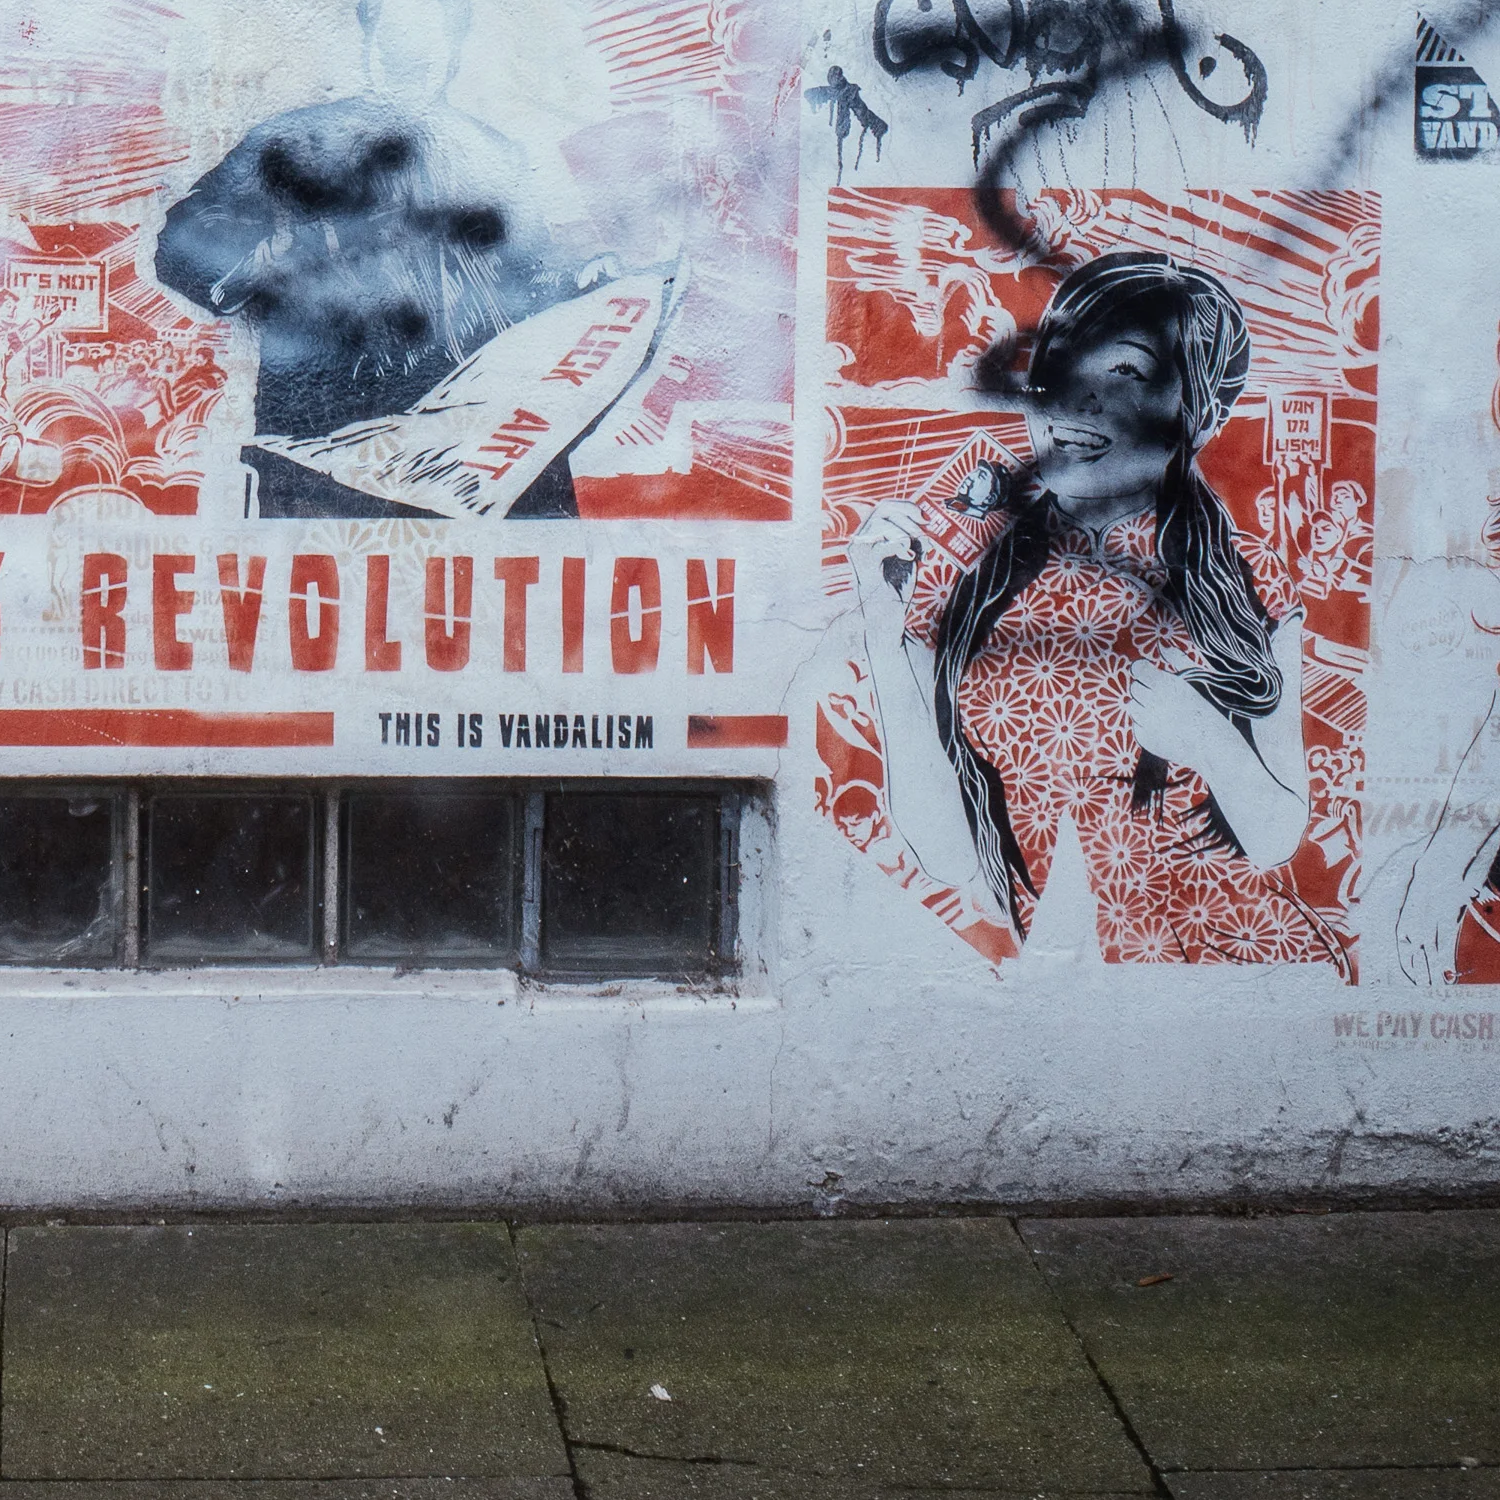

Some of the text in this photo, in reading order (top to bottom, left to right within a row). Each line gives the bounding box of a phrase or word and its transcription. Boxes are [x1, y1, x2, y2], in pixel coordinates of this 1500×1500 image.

[13, 271, 99, 291] IT'S NOT
[539, 297, 651, 388] FUCK
[1282, 399, 1315, 414] VAN
[462, 407, 553, 481] ART
[1275, 438, 1320, 453] LISM!
[81, 550, 738, 676] REVOLUTION
[378, 712, 655, 749] THIS IS VANDALISM
[1333, 1011, 1494, 1041] WE PAY CASH
